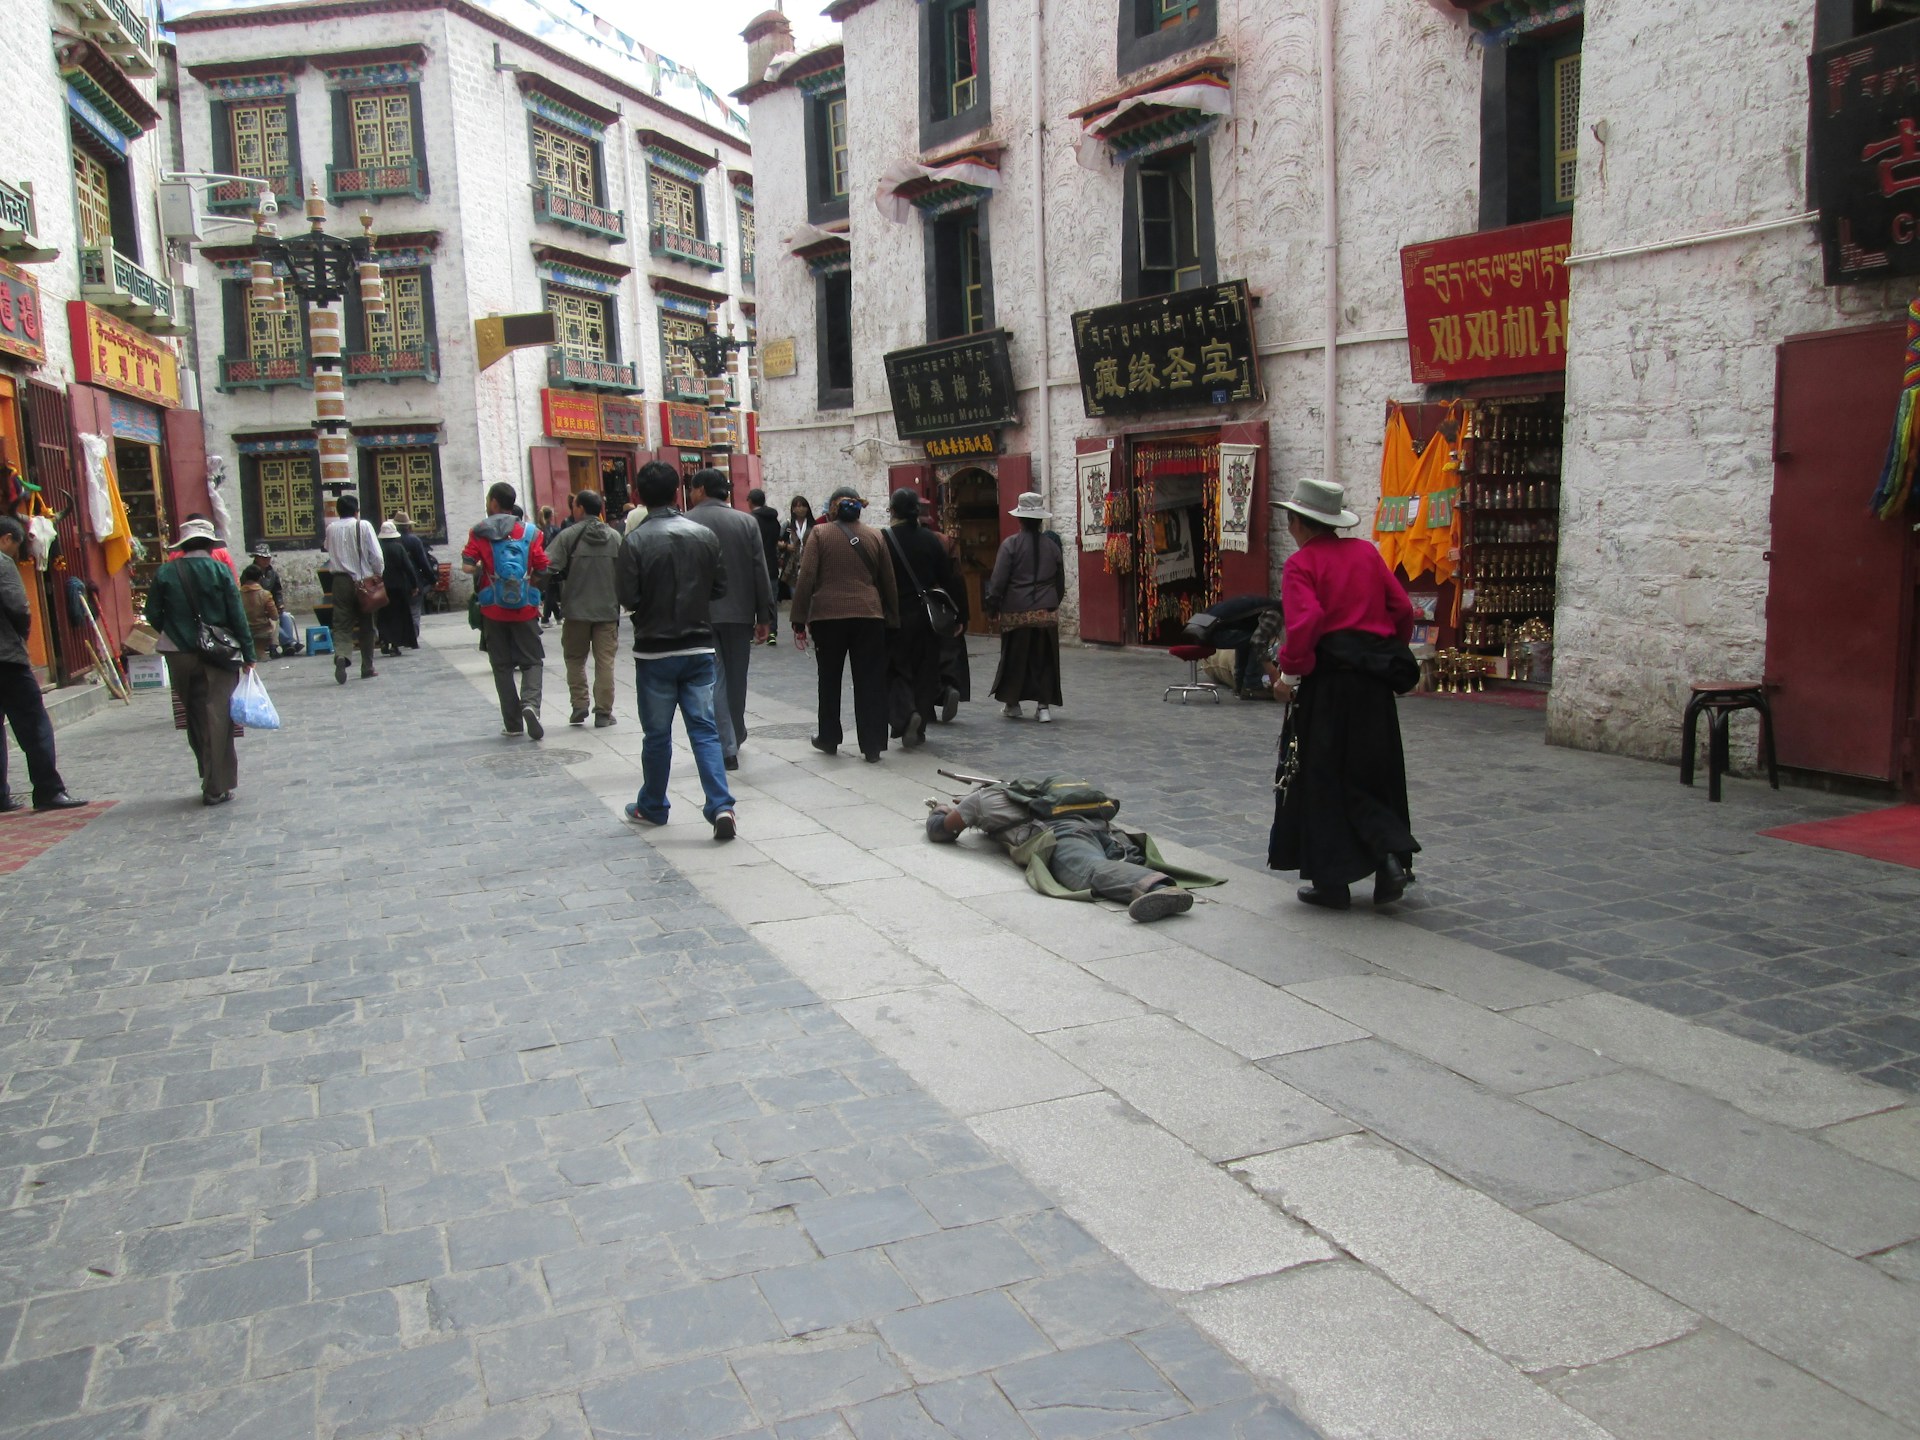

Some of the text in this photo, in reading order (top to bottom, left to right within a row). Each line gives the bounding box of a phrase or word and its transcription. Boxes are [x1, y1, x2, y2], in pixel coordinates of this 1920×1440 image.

[1891, 211, 1920, 245] C
[1093, 337, 1239, 399] 藏缘圣宝
